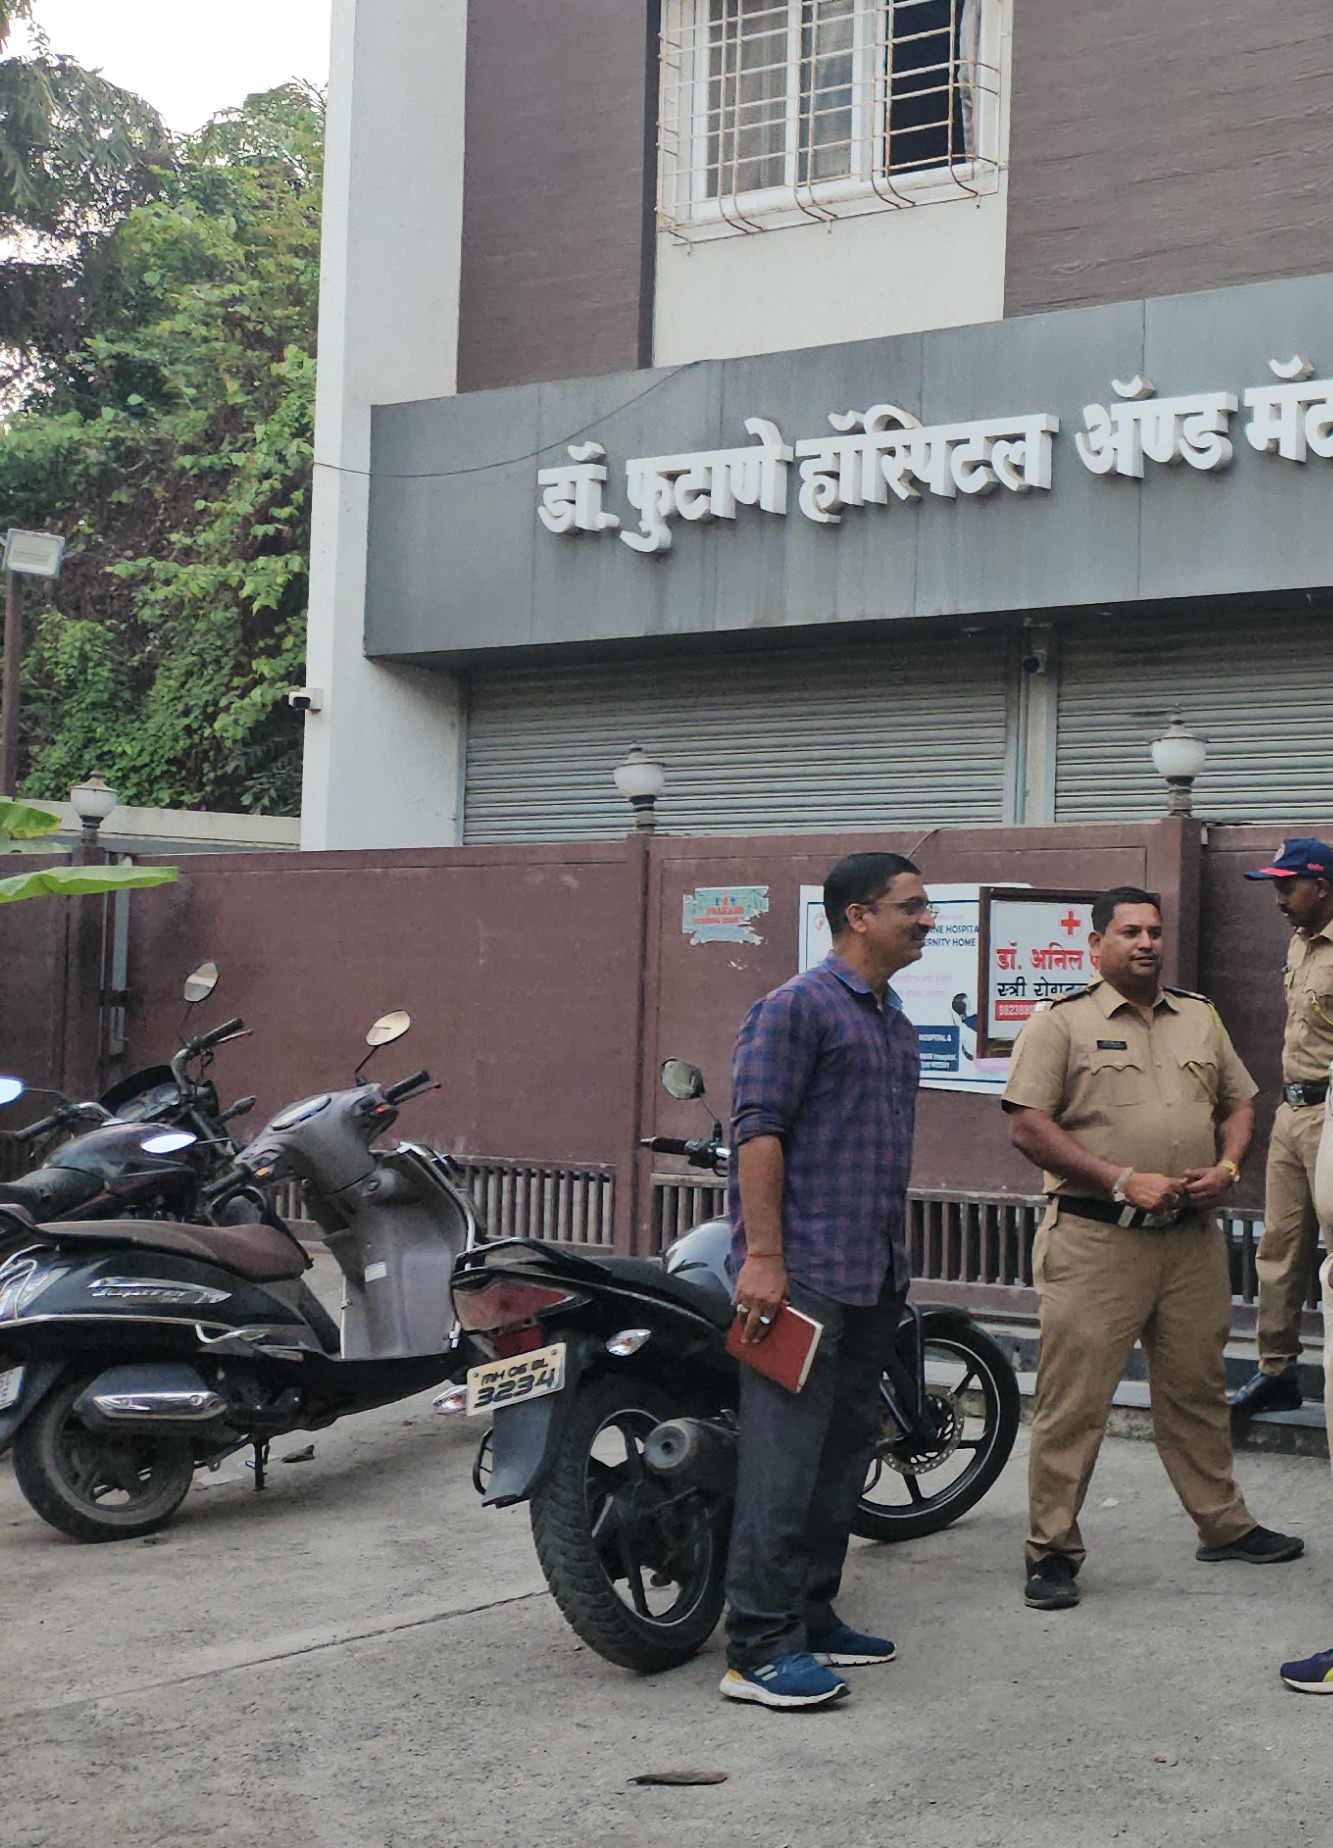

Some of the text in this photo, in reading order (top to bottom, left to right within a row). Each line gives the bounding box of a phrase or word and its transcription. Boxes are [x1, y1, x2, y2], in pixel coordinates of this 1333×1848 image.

[538, 440, 620, 533] डॉ.
[619, 417, 795, 553] फुटाणे
[795, 404, 1060, 524] हॉस्पिटल
[924, 938, 976, 946] ERNITY HOME
[946, 925, 979, 934] HOSPITA
[996, 940, 1022, 970] डॉ.
[1031, 942, 1084, 970] अनिल
[997, 976, 1027, 997] स्त्री
[473, 1367, 556, 1409] 3234
